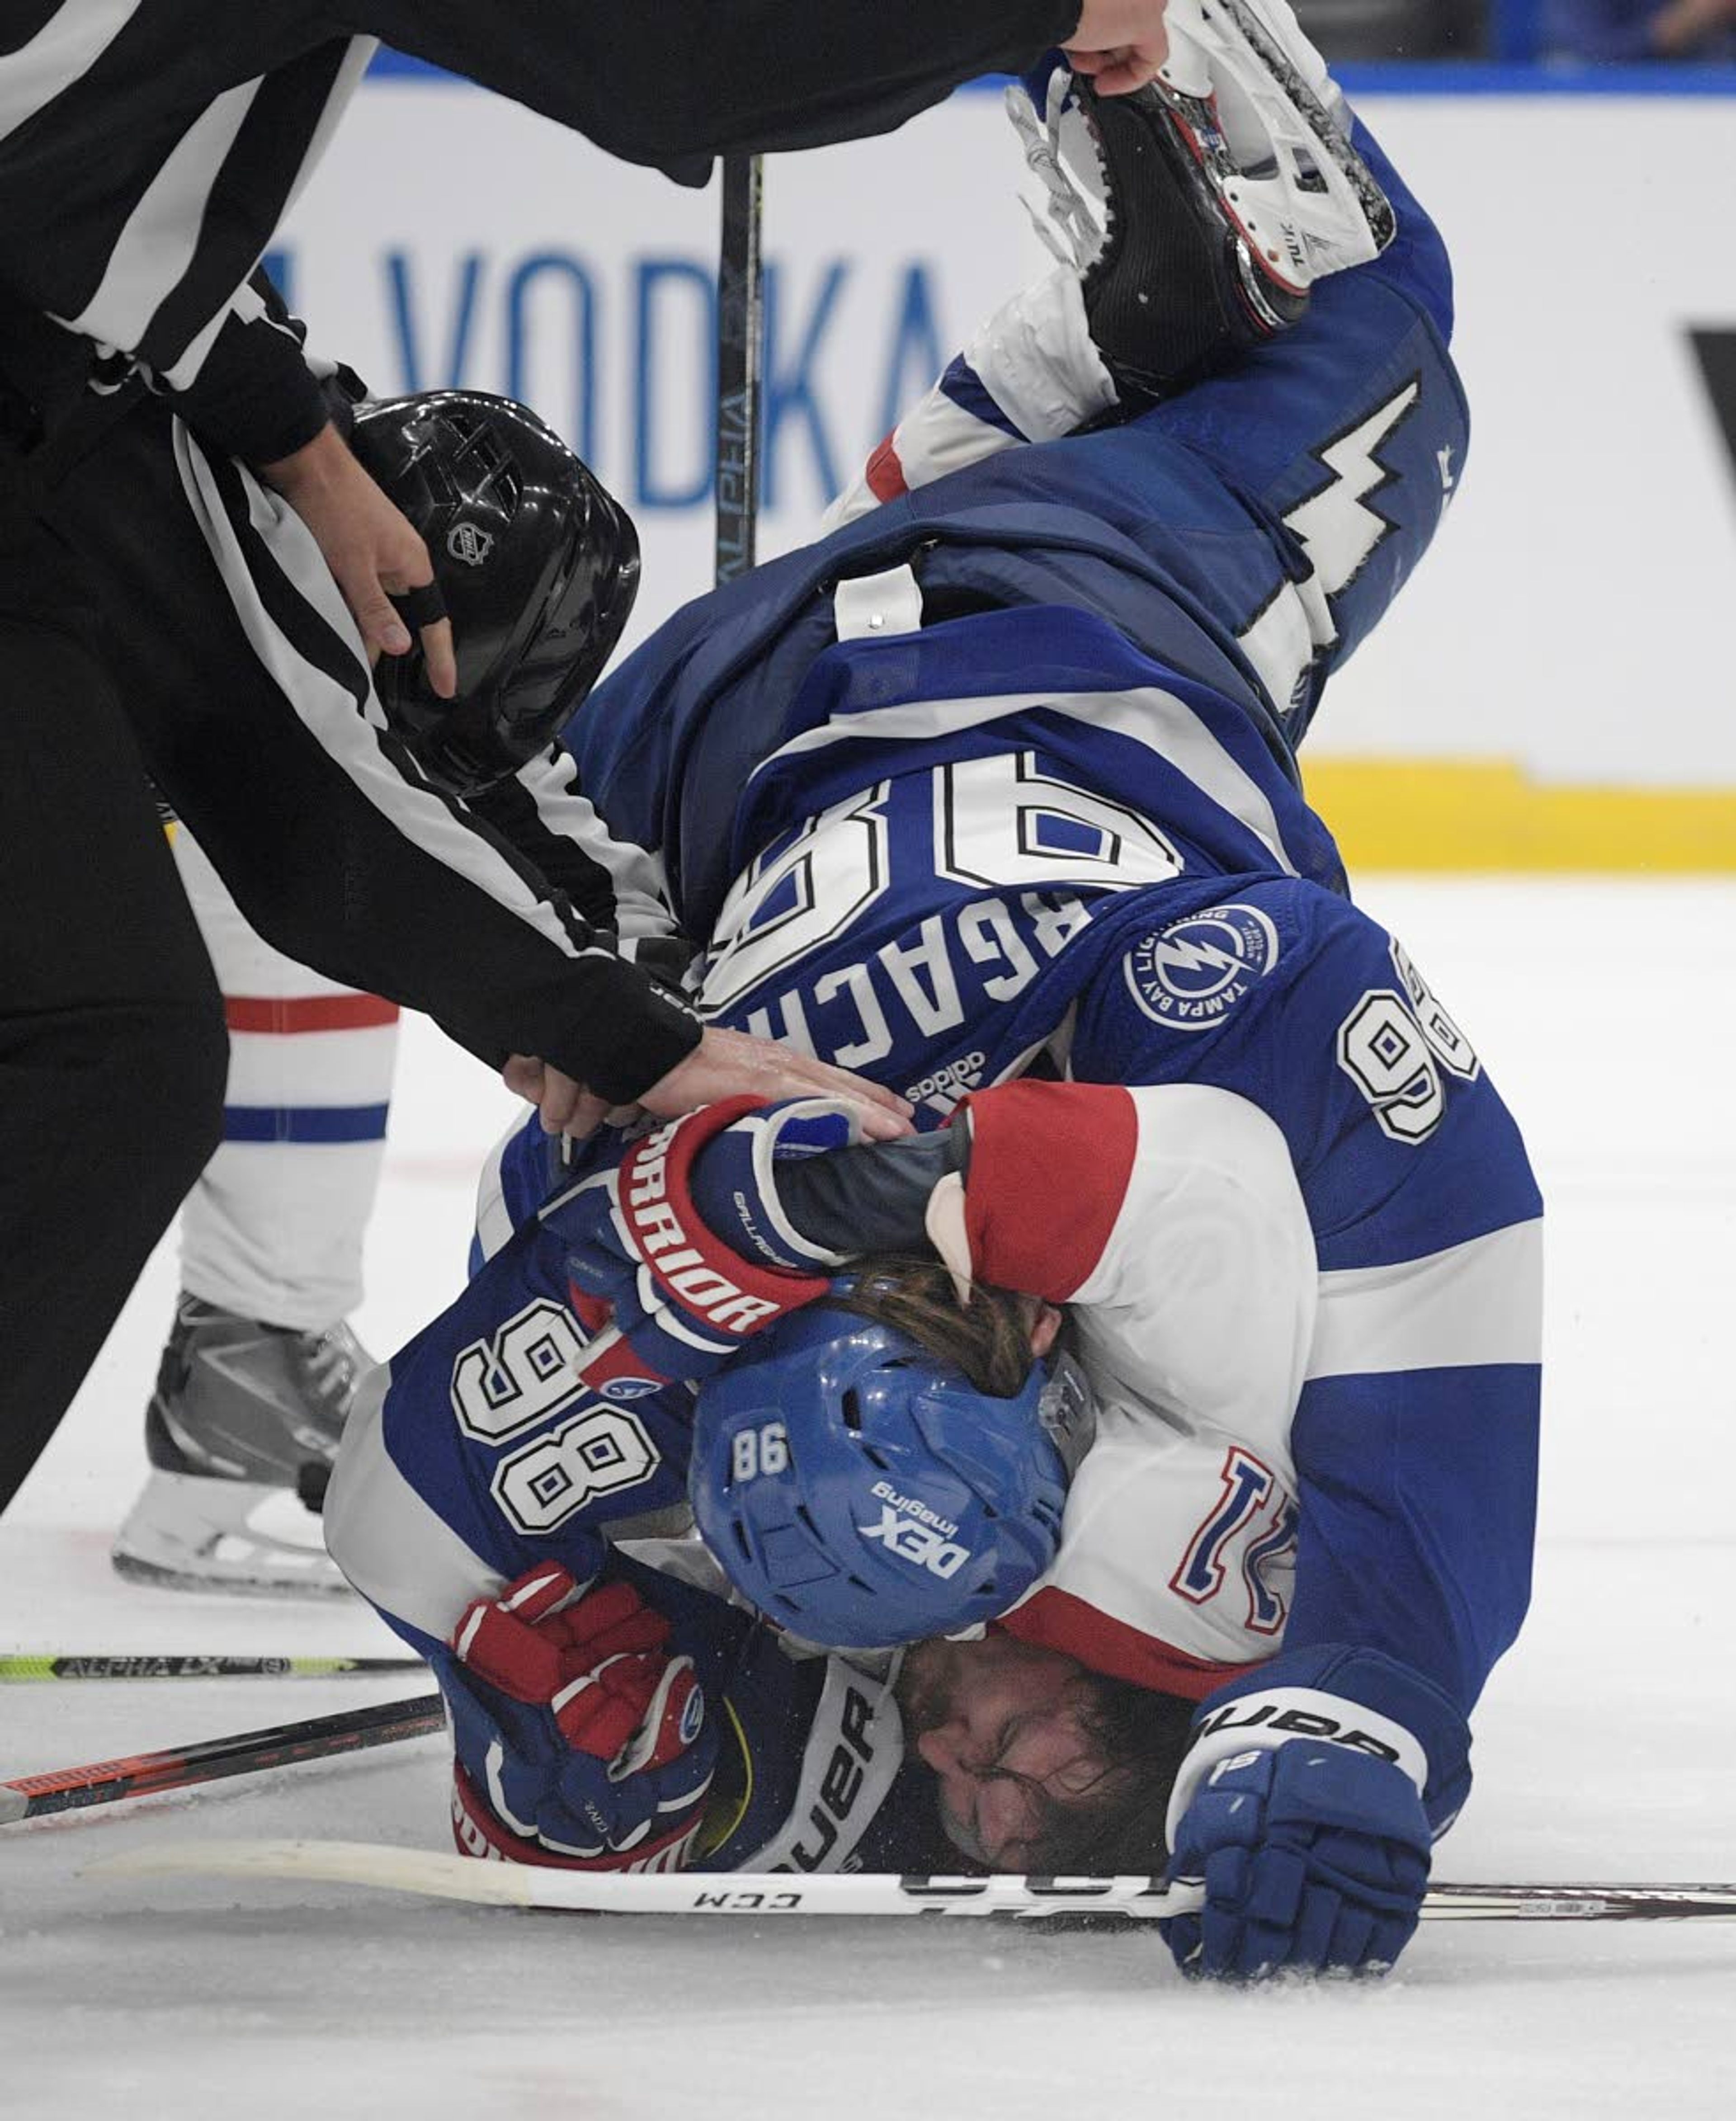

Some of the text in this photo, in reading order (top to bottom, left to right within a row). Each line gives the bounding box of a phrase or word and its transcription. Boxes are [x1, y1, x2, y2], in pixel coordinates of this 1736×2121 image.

[382, 245, 950, 510] VODKA
[718, 390, 749, 580] ALPHA
[729, 892, 1092, 1070] RGACH
[1142, 979, 1175, 1012] BAY
[1178, 982, 1248, 1017] TAMPA
[1337, 935, 1481, 1144] 98
[904, 1051, 986, 1103] adidas
[630, 1105, 781, 1333] ARRIOR
[451, 1296, 661, 1535] 98
[732, 1423, 788, 1482] 98
[859, 1505, 971, 1579] DEX
[1168, 1446, 1300, 1636] 71
[61, 1657, 171, 1678] ALPHA
[179, 1657, 222, 1678] LX
[768, 1686, 874, 1873] UER
[694, 1893, 804, 1909] CCM
